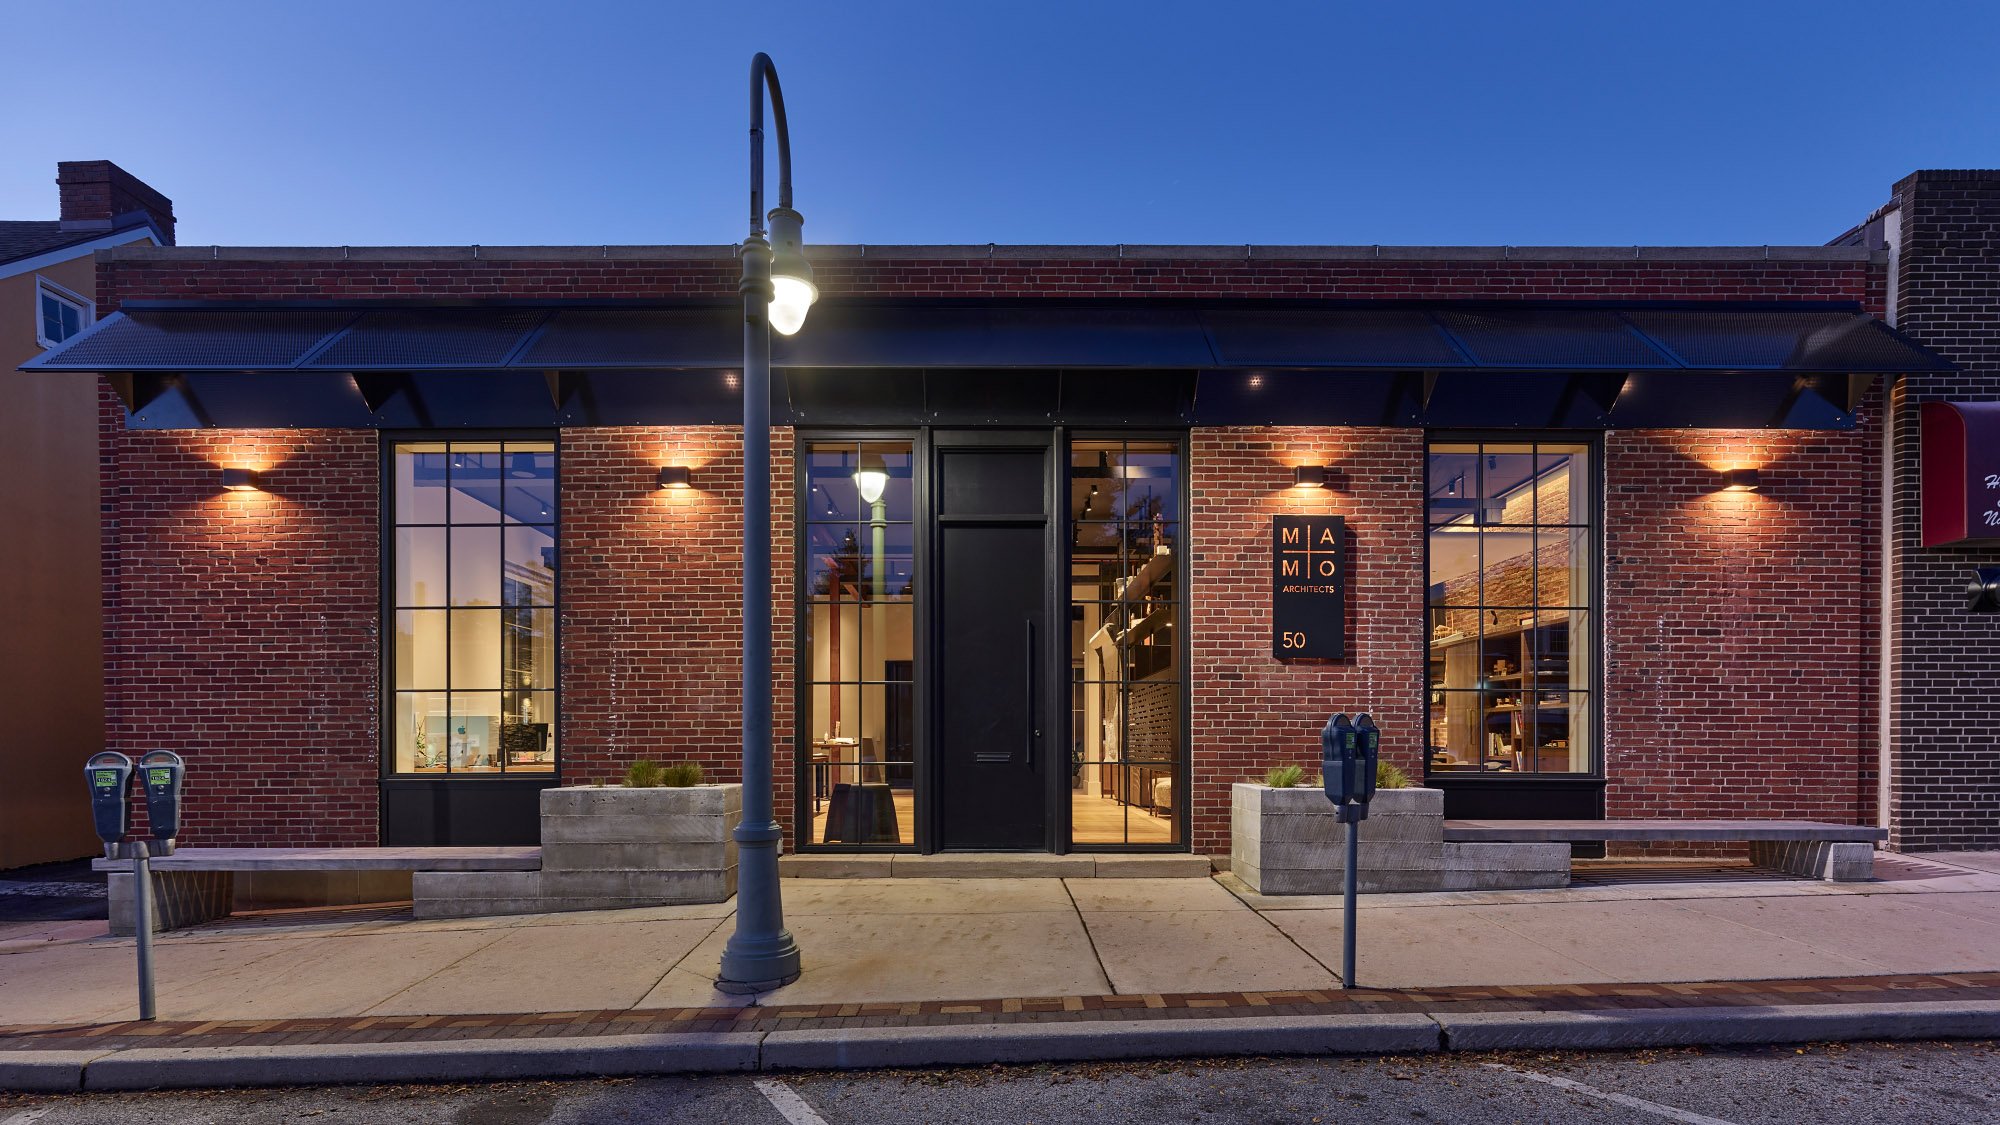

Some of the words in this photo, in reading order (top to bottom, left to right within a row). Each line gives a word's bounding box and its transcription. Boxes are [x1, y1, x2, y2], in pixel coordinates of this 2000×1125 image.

[1984, 474, 2000, 489] H
[1282, 585, 1335, 594] ARCHITECTS
[1282, 631, 1306, 649] 50
